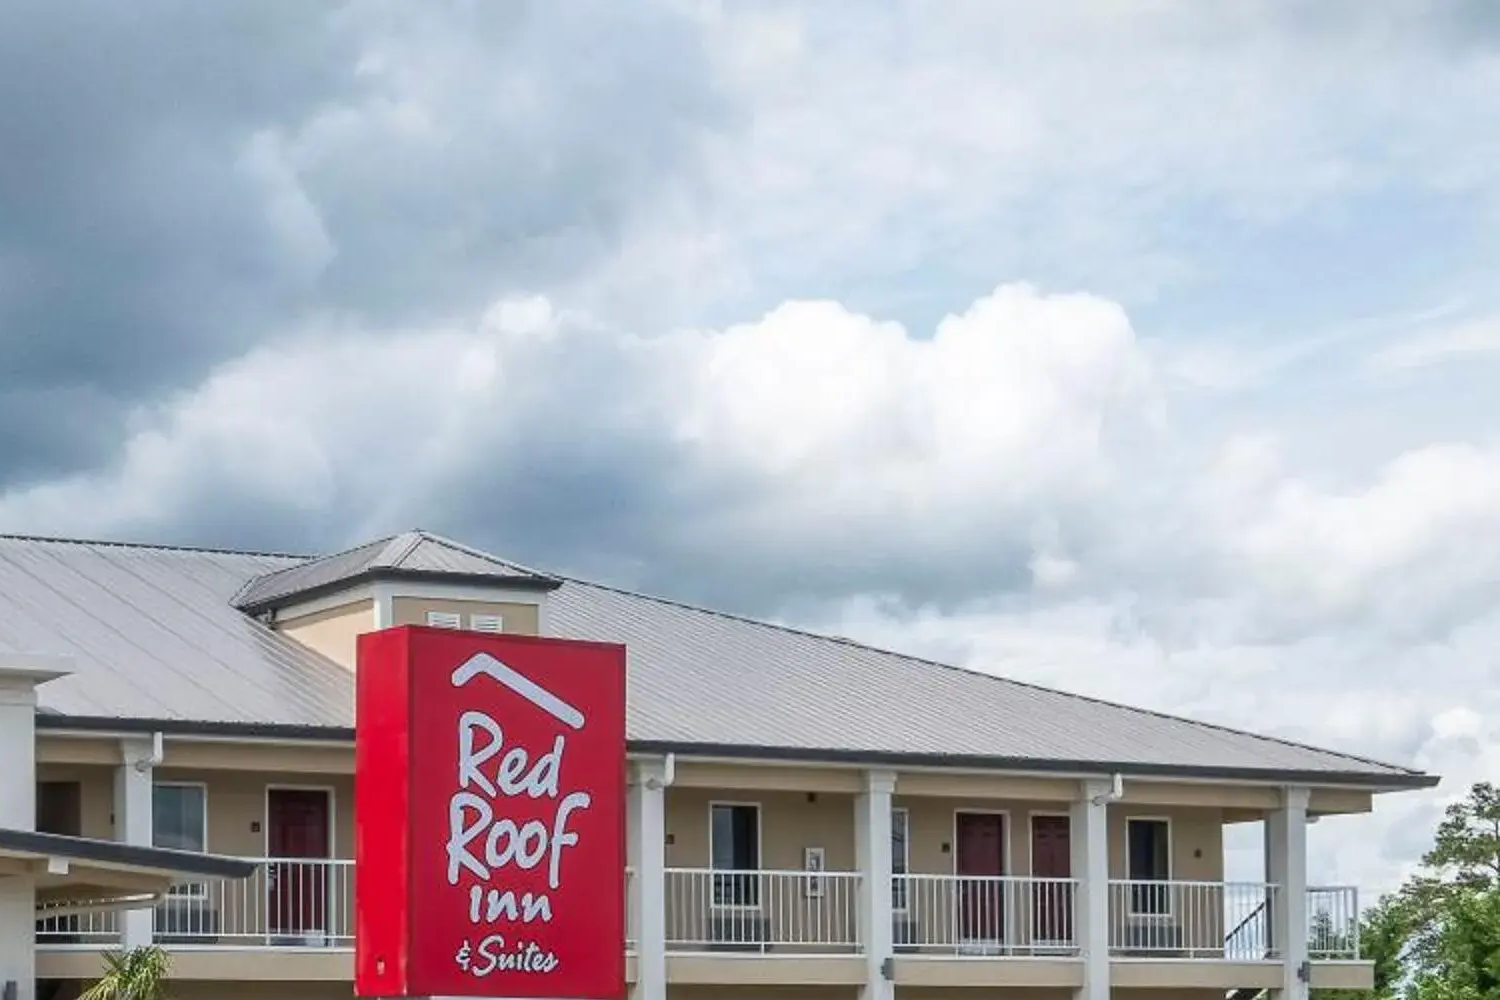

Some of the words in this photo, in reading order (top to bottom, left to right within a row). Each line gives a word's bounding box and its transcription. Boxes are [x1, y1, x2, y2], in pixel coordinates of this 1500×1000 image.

[458, 711, 566, 799] Red
[445, 791, 592, 889] Roof
[455, 940, 472, 971] &
[472, 935, 560, 977] Suites
